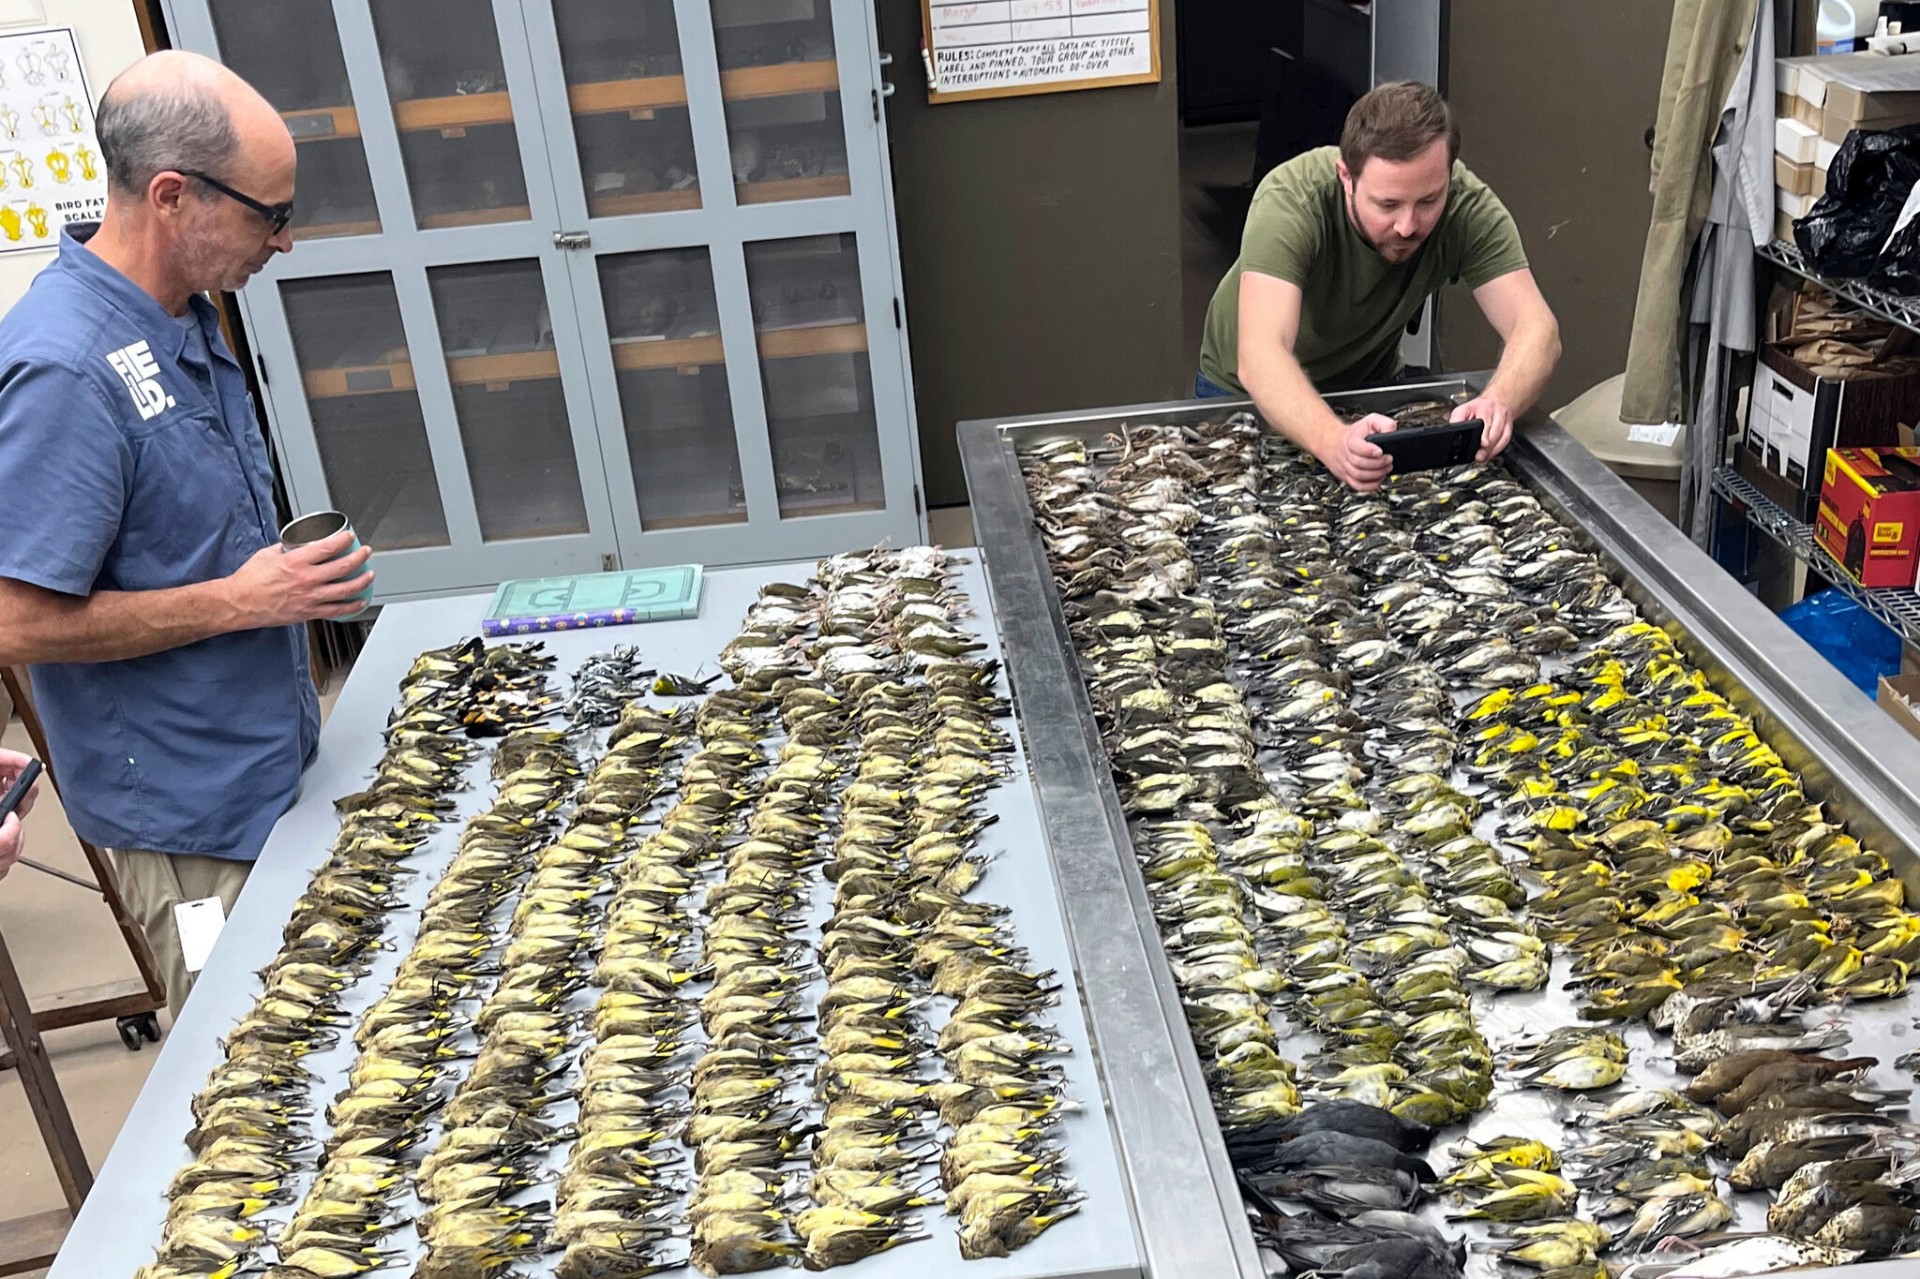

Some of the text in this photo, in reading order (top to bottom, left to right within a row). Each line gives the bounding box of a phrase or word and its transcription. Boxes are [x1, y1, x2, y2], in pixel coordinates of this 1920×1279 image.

[937, 50, 974, 62] RULES:
[1058, 42, 1079, 51] DATA
[939, 63, 965, 74] LABEL
[969, 61, 986, 71] AND
[1058, 50, 1088, 62] GROUP
[1088, 50, 1106, 60] AND
[1108, 47, 1135, 57] OTHER
[940, 68, 1011, 84] INTERRUPTIONS
[1019, 64, 1064, 78] AUTOMATIC
[55, 198, 105, 211] BIRD FAT
[64, 210, 103, 222] SCALE
